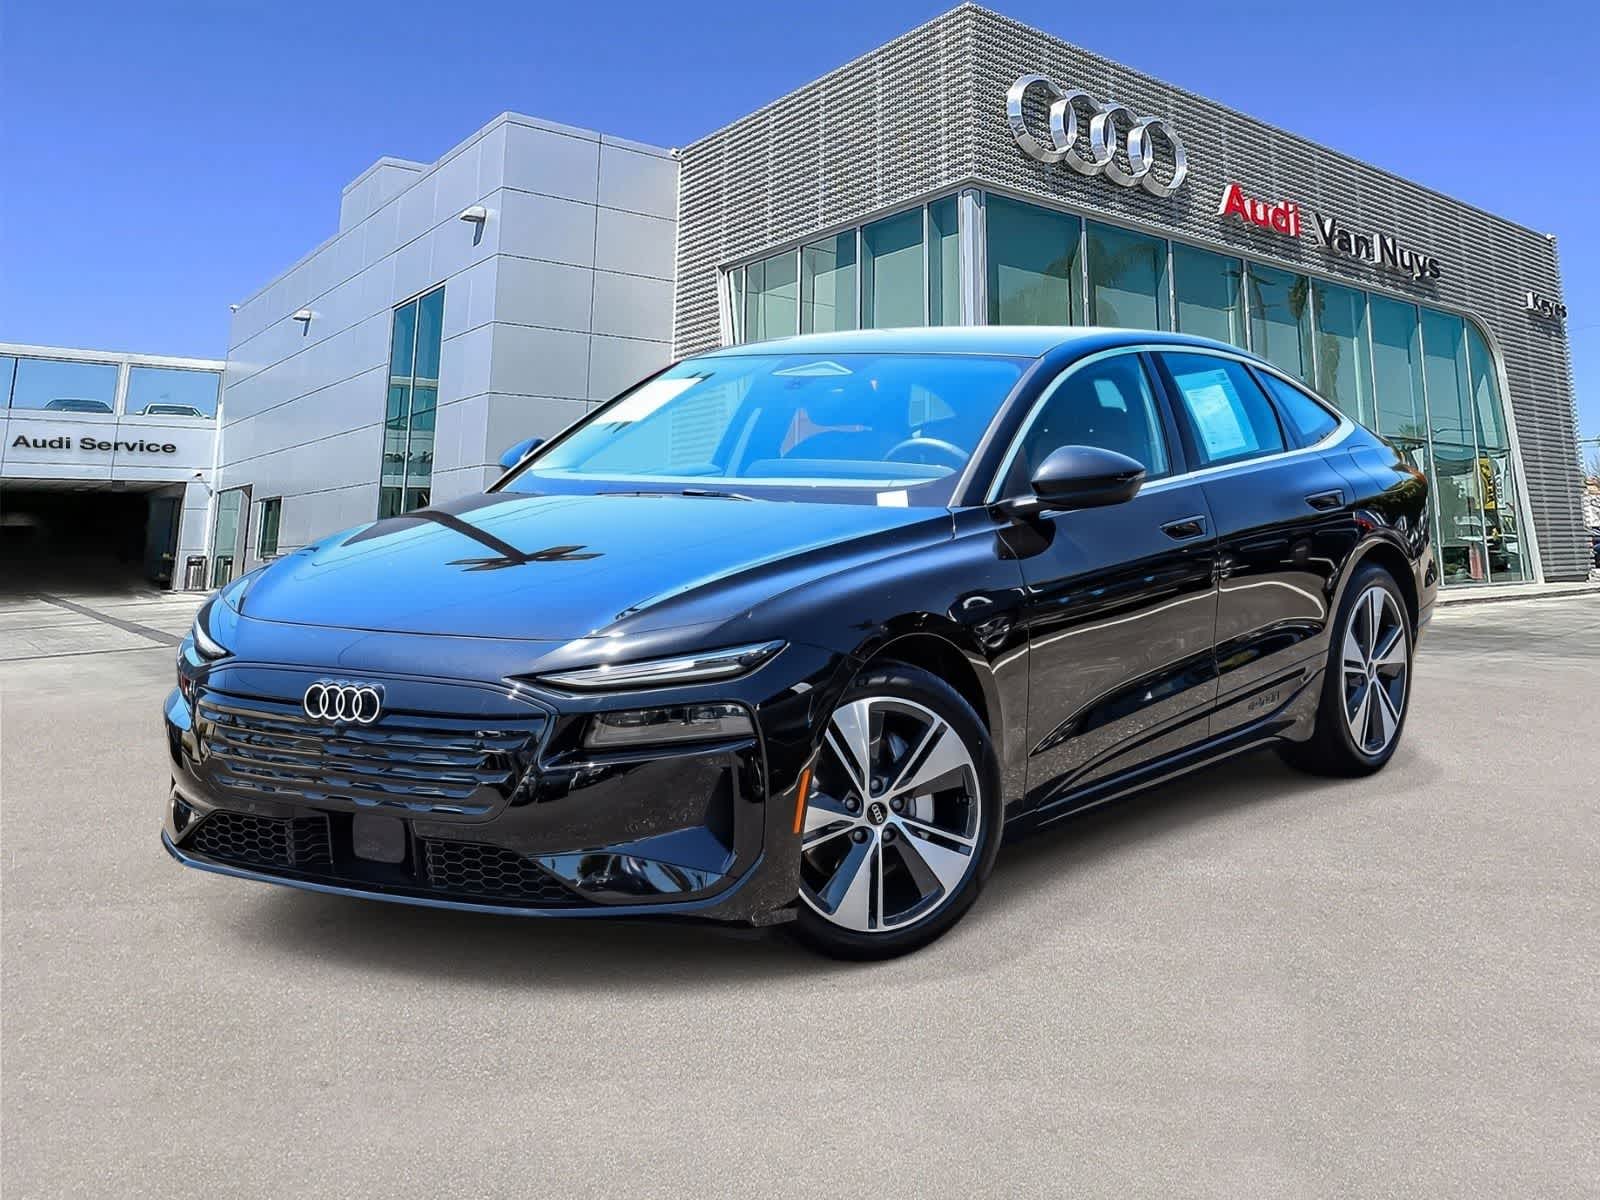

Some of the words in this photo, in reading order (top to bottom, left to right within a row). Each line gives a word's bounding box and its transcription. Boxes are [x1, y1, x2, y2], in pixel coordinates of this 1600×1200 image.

[1217, 183, 1301, 238] Audi
[1310, 213, 1373, 259] Van
[1374, 233, 1441, 281] Nuys
[12, 435, 71, 449] Audi
[79, 437, 177, 453] Service
